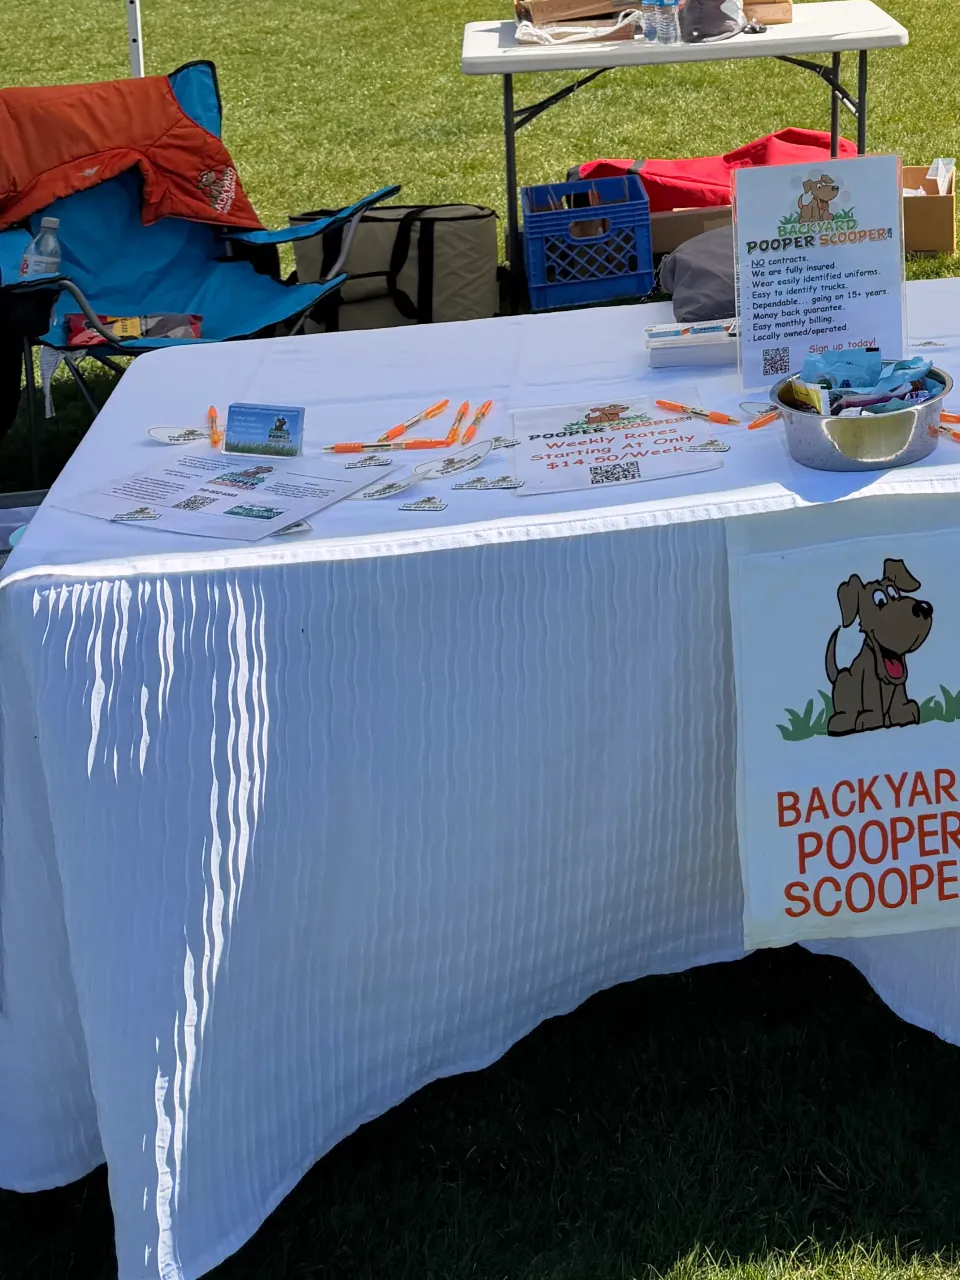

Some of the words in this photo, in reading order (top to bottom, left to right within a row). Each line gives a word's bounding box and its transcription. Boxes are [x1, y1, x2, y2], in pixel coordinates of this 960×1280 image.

[777, 219, 858, 237] BACKYARD
[746, 235, 815, 254] POOPER
[819, 228, 887, 246] SCOOPER
[751, 260, 765, 268] NO
[768, 256, 809, 266] contracts.
[751, 270, 765, 278] We
[786, 266, 803, 275] fully
[806, 261, 838, 271] insured.
[752, 280, 774, 288] Wear
[777, 276, 801, 287] easily
[803, 271, 841, 283] identified
[844, 268, 881, 278] uniforms.
[752, 291, 771, 300] Easy
[774, 289, 783, 297] to
[786, 285, 817, 296] identify
[821, 282, 848, 292] trucks.
[752, 298, 808, 310] Dependable...
[811, 295, 832, 305] going
[847, 291, 862, 299] 15+
[865, 289, 890, 298] years.
[781, 308, 801, 317] back
[803, 304, 846, 317] guarantee.
[752, 322, 772, 332] Easy
[775, 318, 806, 329] monthly
[809, 315, 835, 325] billing.
[753, 332, 781, 342] Locally
[783, 323, 850, 338] owned/operated.
[809, 345, 829, 354] Sign
[847, 337, 876, 349] today!
[528, 427, 607, 441] POOPER
[610, 417, 687, 432] SCOOPER
[530, 446, 611, 461] Starting
[621, 441, 644, 450] At
[653, 434, 696, 446] Only
[545, 435, 615, 450] Weekly
[624, 428, 678, 440] Rates
[546, 445, 684, 470] $14.50/Week
